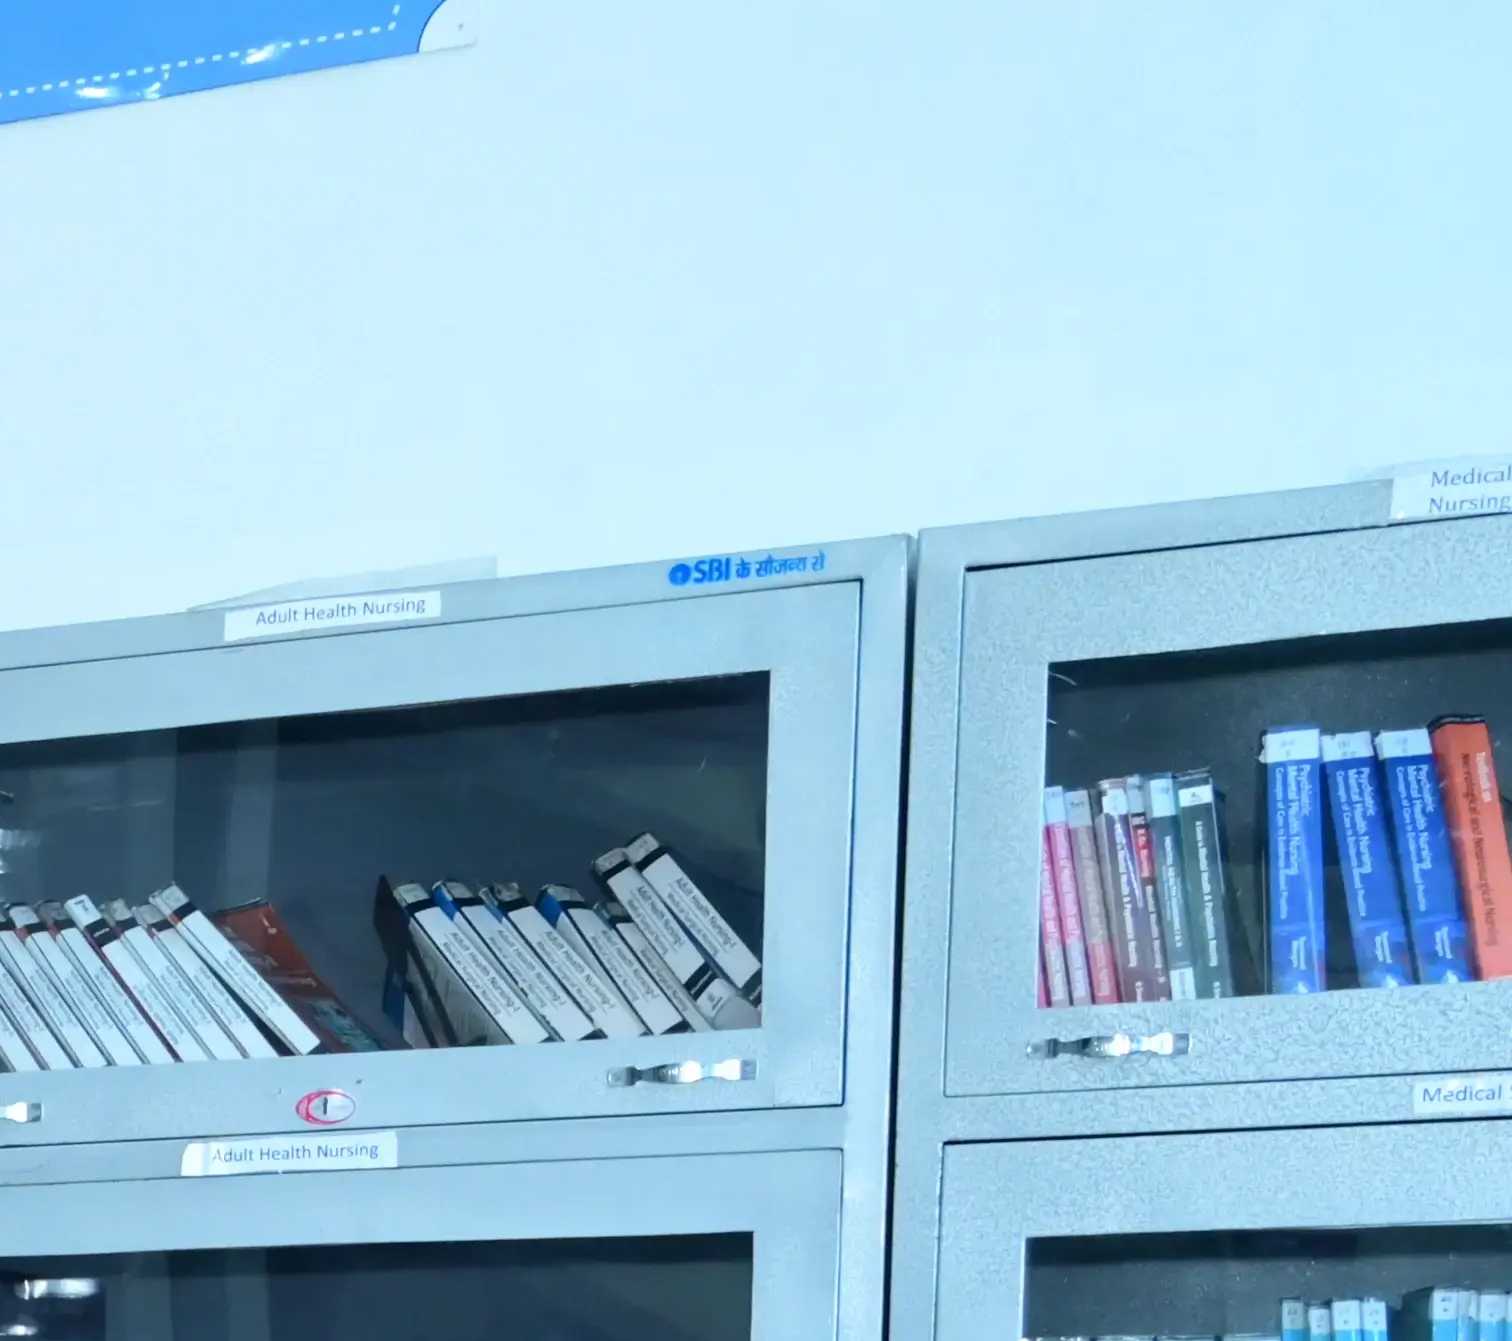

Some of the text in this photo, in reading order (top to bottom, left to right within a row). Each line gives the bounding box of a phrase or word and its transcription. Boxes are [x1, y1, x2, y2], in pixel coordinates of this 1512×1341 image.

[1431, 465, 1512, 487] Medical
[1429, 494, 1511, 513] Nursing
[693, 557, 730, 584] SBI
[256, 596, 426, 628] Adult Health Nursing
[1413, 800, 1426, 831] Health
[1418, 832, 1432, 870] Nursing
[1421, 1084, 1503, 1104] Medical
[212, 1144, 379, 1163] Adult Health Nursing
